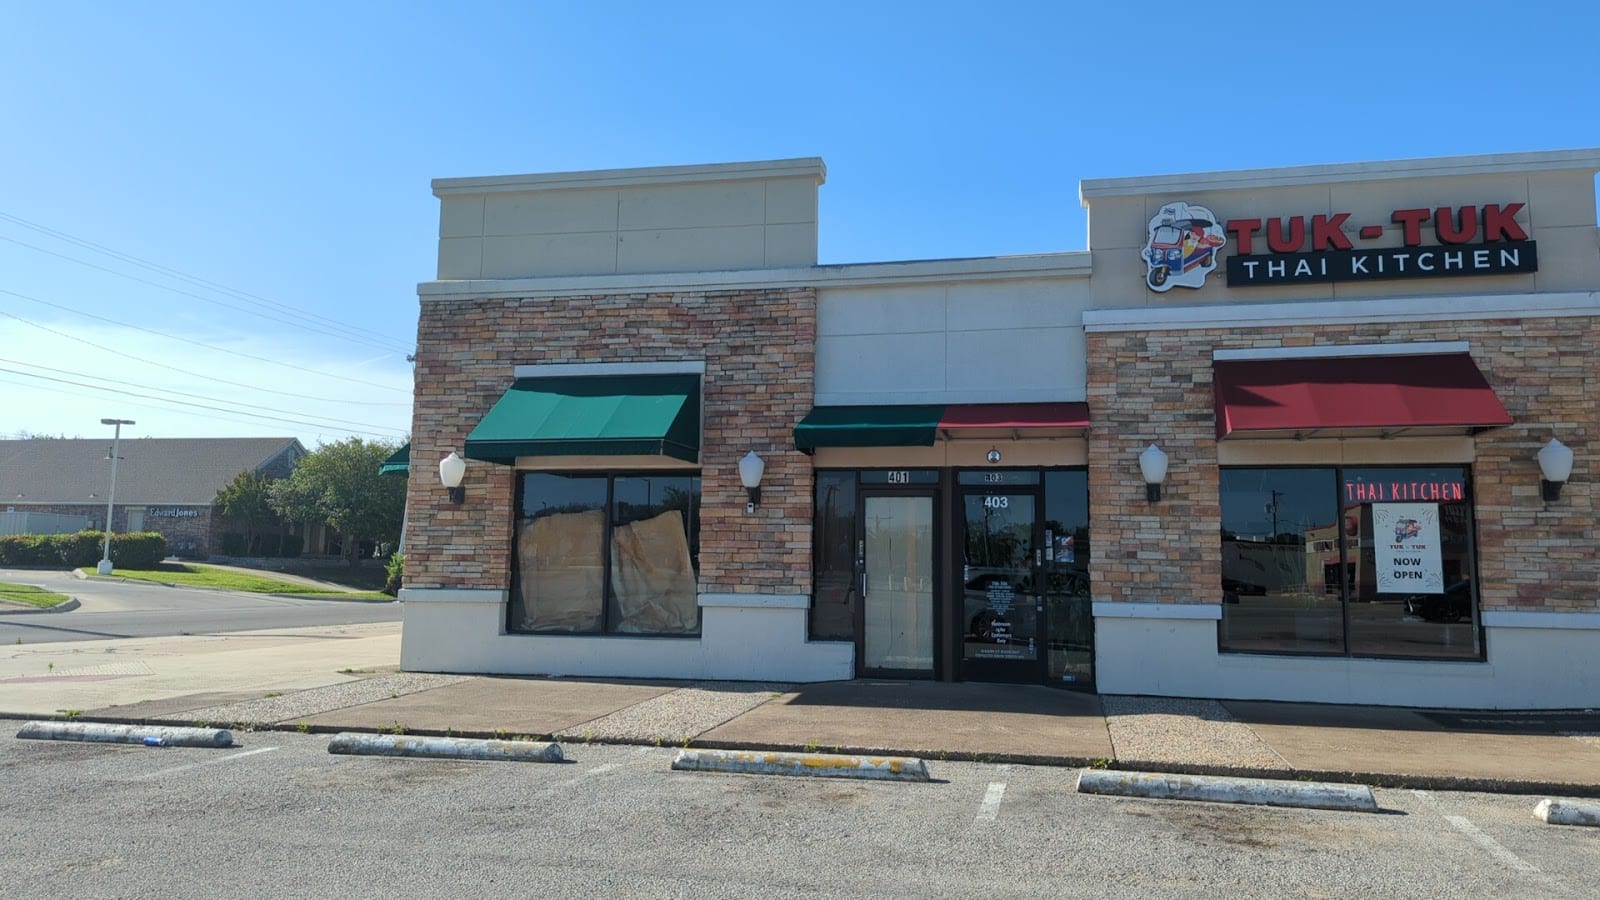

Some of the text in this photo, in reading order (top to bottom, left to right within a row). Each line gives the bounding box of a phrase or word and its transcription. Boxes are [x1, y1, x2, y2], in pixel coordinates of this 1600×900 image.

[1243, 247, 1521, 280] THAI KITCHEN
[889, 471, 909, 483] 401
[1345, 482, 1462, 501] THAI KITCHEN
[984, 496, 1008, 508] 403
[1393, 558, 1421, 566] NOW
[1393, 571, 1423, 579] OPEN
